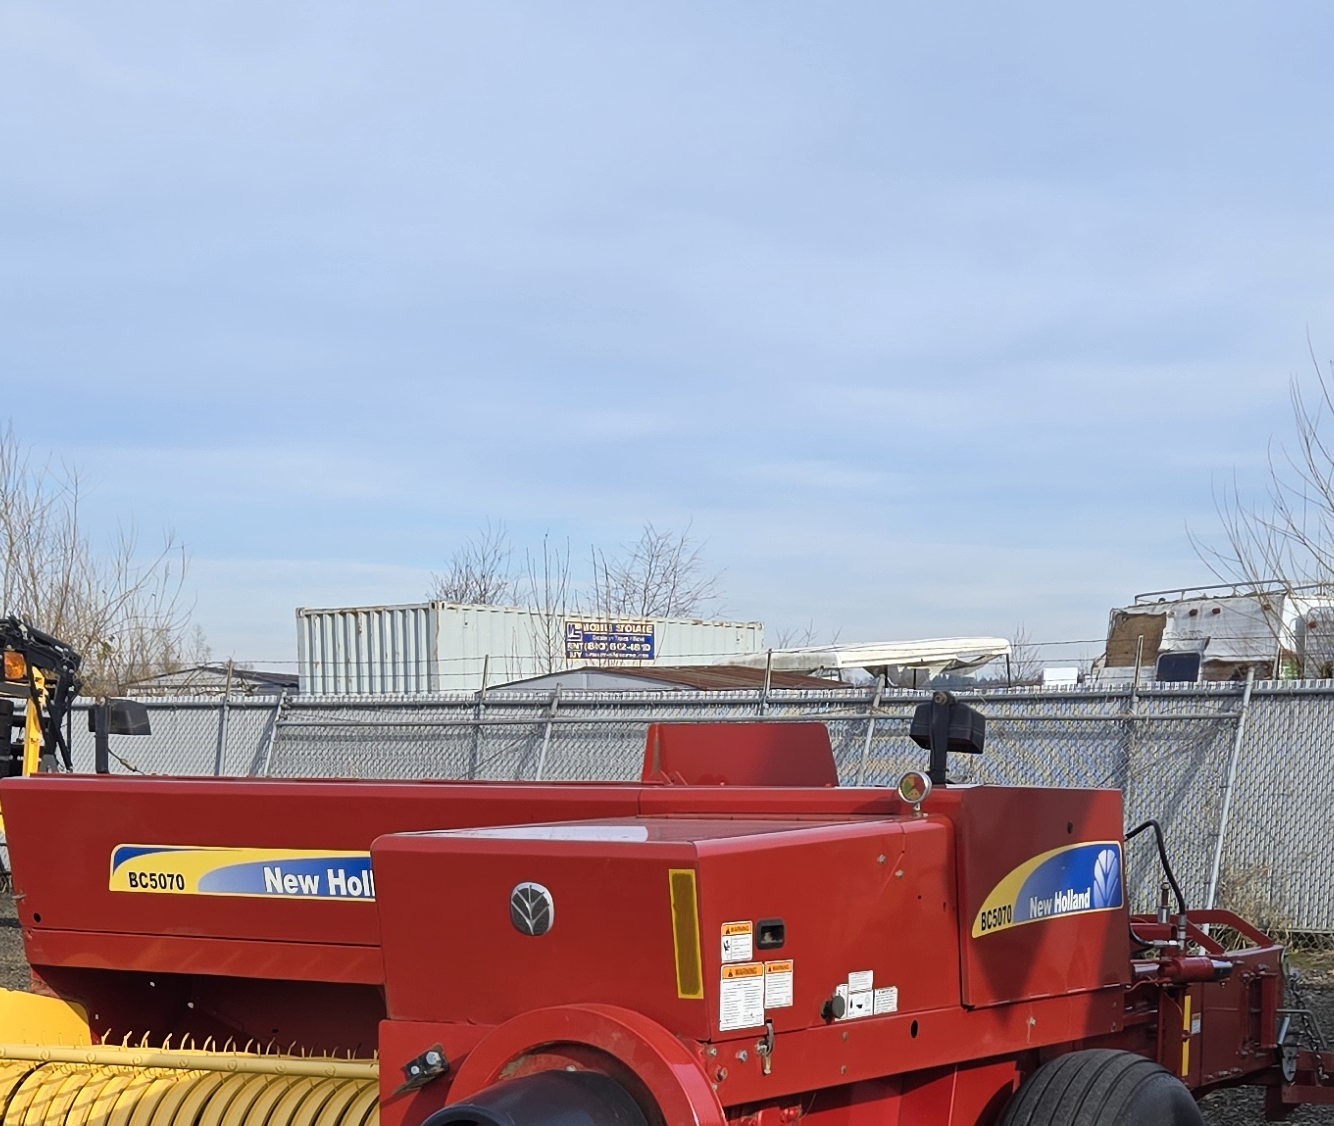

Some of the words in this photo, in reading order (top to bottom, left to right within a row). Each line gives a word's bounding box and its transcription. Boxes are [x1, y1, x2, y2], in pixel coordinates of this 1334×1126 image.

[128, 871, 185, 890] BC5070
[263, 866, 319, 895] New
[981, 904, 1012, 931] BC5070
[1029, 896, 1053, 919] New
[1054, 887, 1091, 913] Holland
